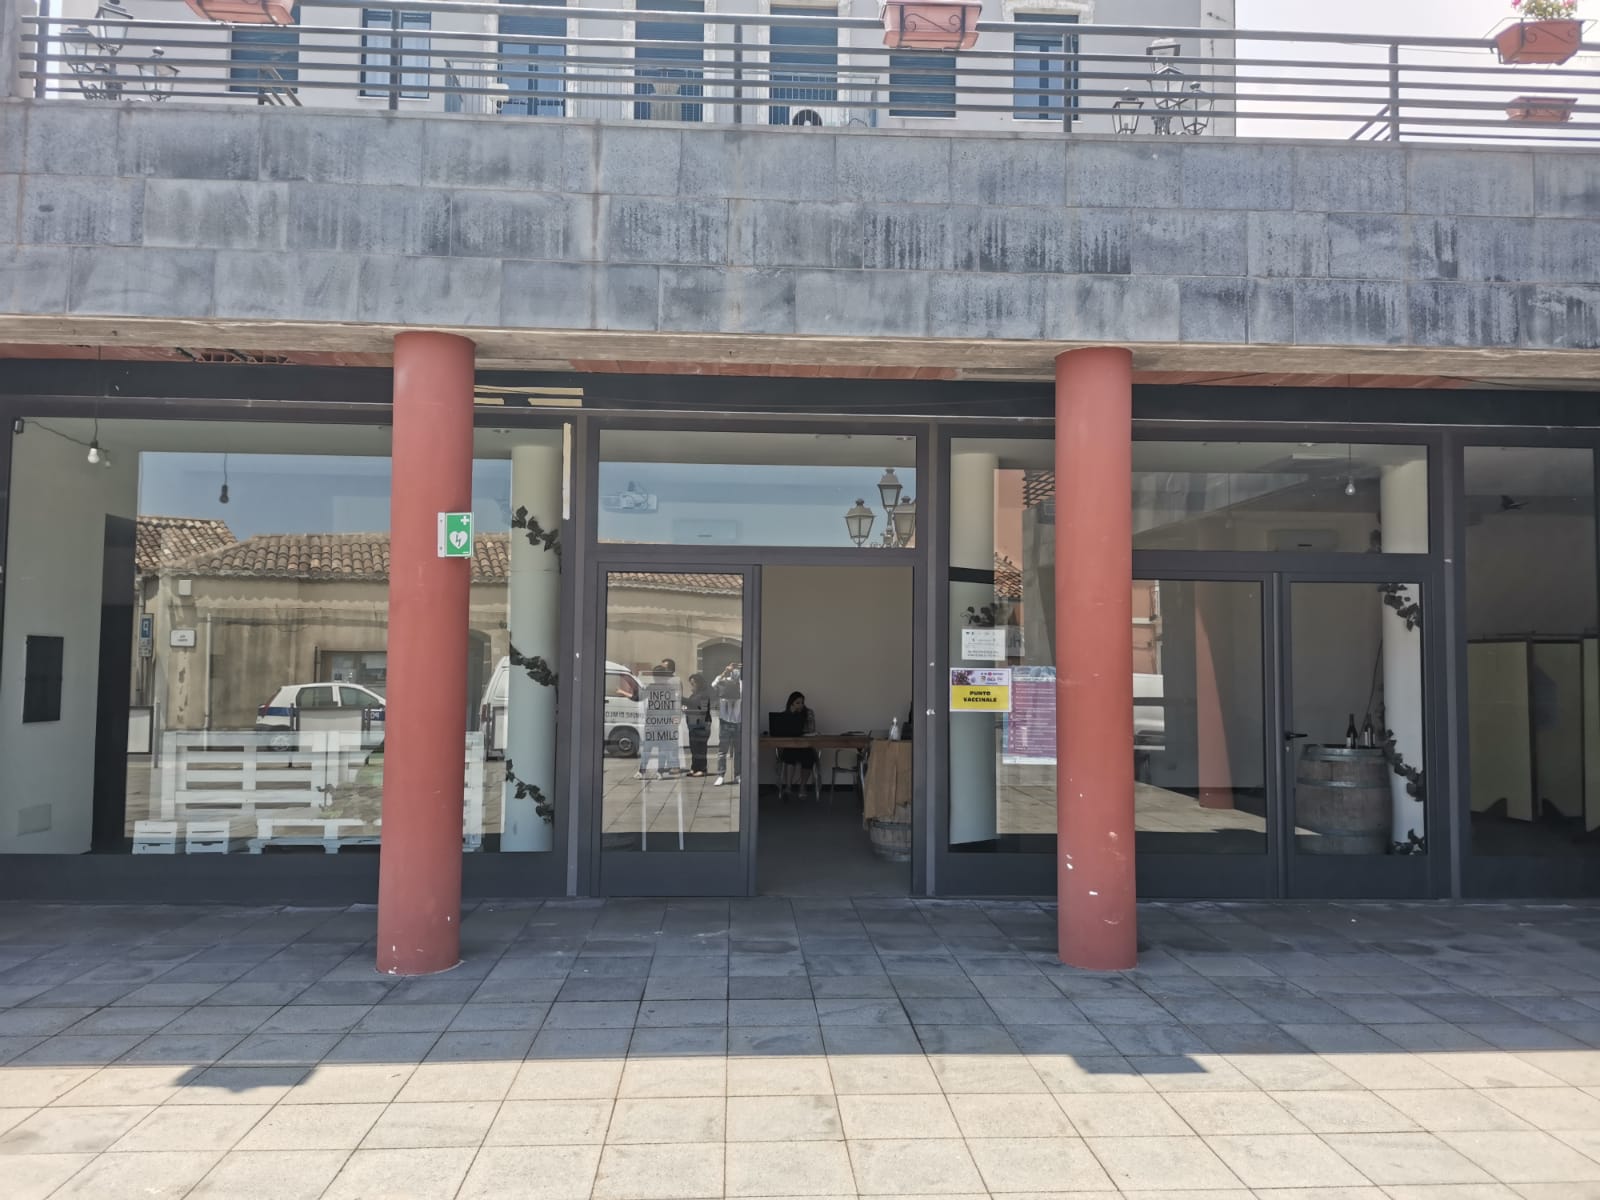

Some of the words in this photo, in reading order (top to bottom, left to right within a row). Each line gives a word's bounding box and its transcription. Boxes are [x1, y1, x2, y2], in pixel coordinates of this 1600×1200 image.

[649, 690, 671, 700] INFO
[648, 700, 675, 710] POINT
[645, 731, 655, 742] DI
